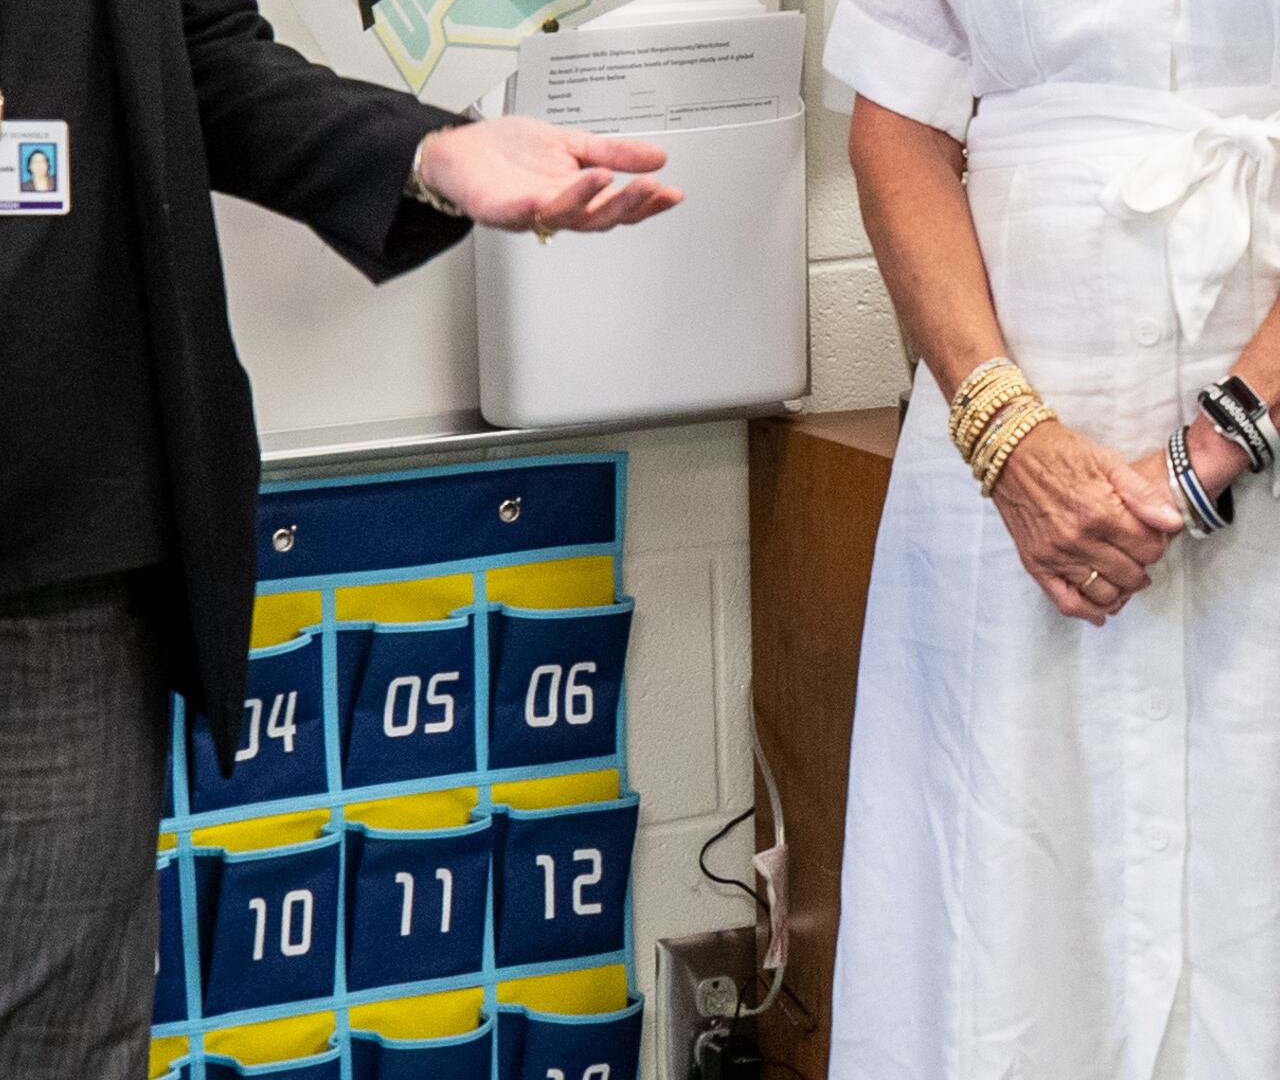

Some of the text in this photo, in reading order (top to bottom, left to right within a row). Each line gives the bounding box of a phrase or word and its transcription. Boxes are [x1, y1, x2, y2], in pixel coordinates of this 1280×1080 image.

[383, 671, 460, 738] 05
[525, 662, 597, 728] 06
[395, 867, 454, 936] 11
[536, 848, 603, 919] 12
[248, 889, 314, 960] 10
